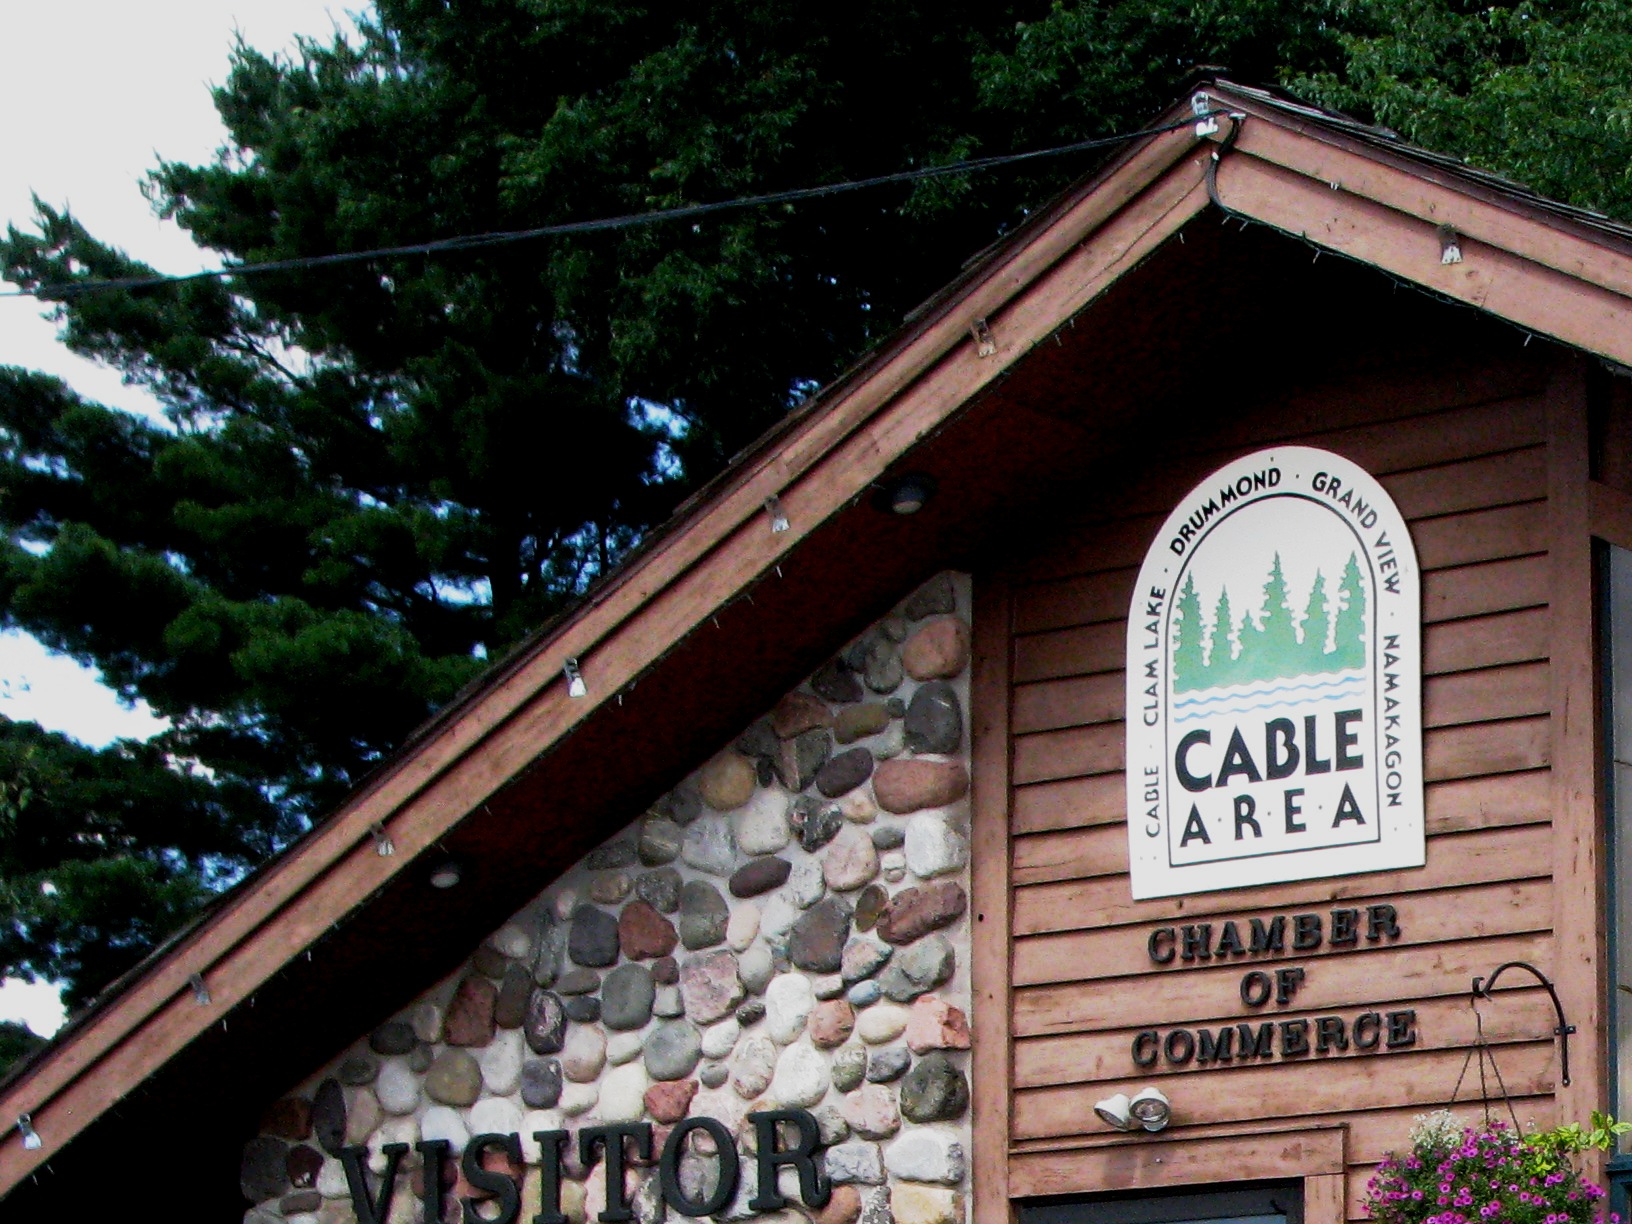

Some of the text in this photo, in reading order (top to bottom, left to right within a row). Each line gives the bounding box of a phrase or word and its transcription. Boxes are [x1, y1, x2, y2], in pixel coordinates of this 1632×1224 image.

[1143, 466, 1404, 838] CABLE CLAM LAKE DRUMMOND GRAND VIEW NAMAKAGON
[1174, 708, 1365, 793] CABLE
[1147, 903, 1401, 963] CHAMBER
[1239, 967, 1305, 1007] OF
[1131, 1010, 1417, 1066] COMMERCE
